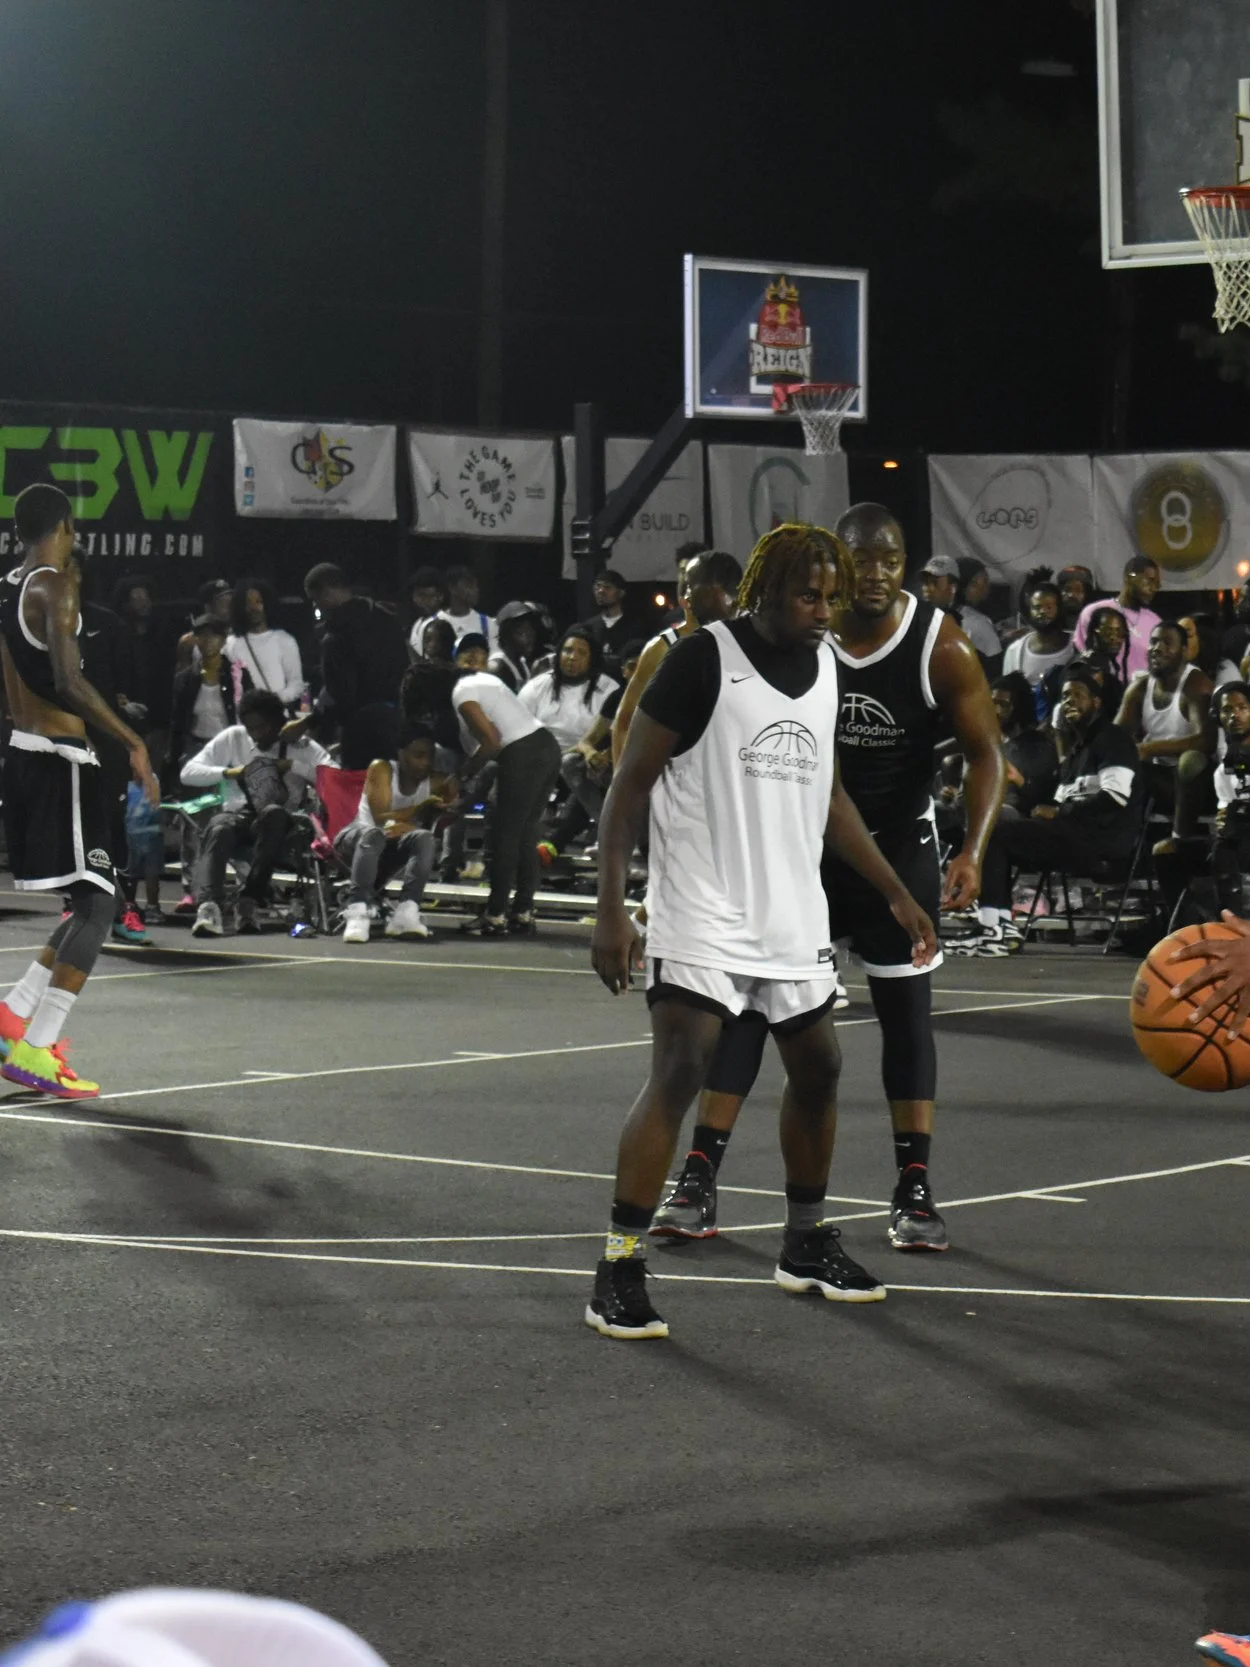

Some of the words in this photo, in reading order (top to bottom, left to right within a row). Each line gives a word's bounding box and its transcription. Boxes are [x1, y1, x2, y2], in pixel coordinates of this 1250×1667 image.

[459, 449, 480, 481] THE
[481, 445, 516, 481] GAME
[460, 487, 496, 528] LOVES
[846, 721, 905, 737] Goodman
[738, 747, 779, 768] George
